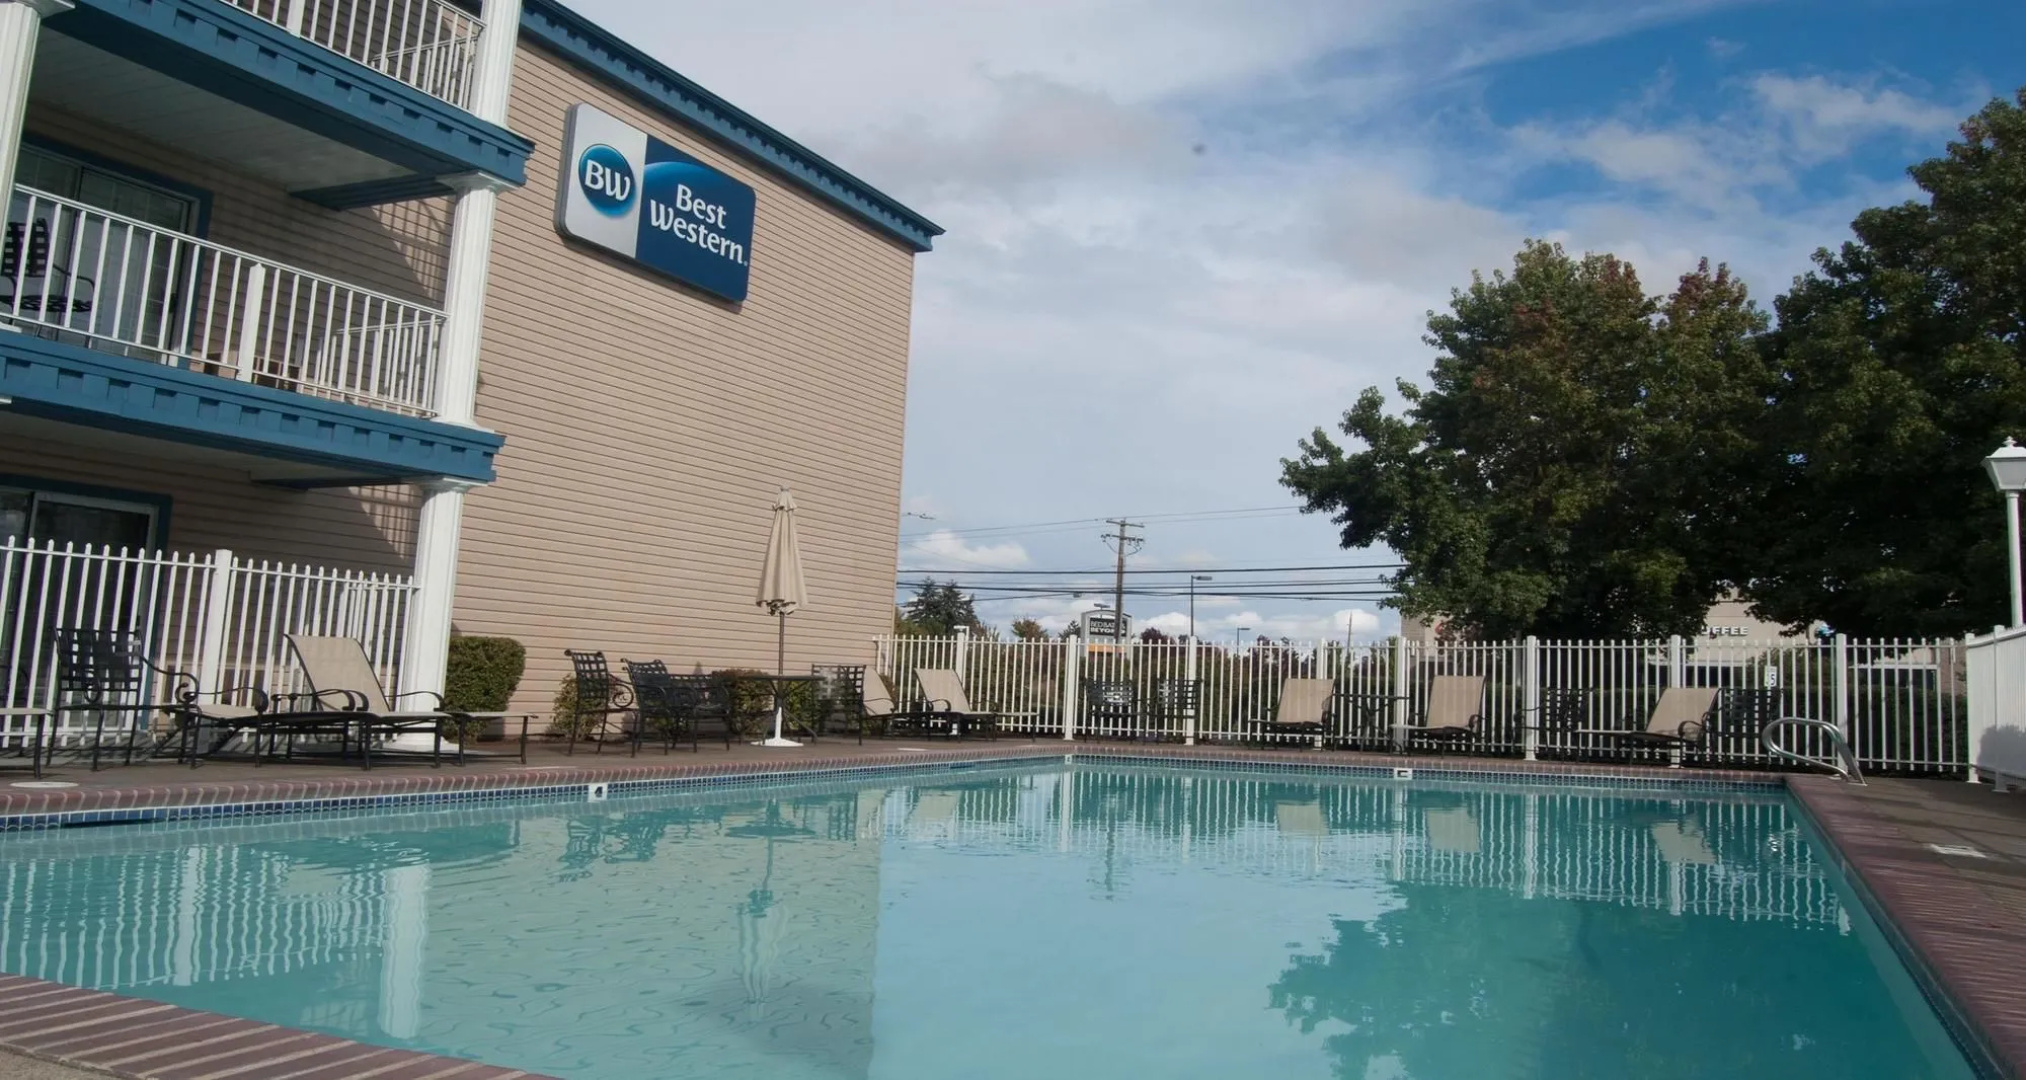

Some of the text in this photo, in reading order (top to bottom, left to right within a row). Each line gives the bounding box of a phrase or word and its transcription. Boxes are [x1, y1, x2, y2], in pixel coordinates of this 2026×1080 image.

[584, 159, 631, 201] BW
[676, 183, 727, 230] Best
[650, 199, 744, 265] Western
